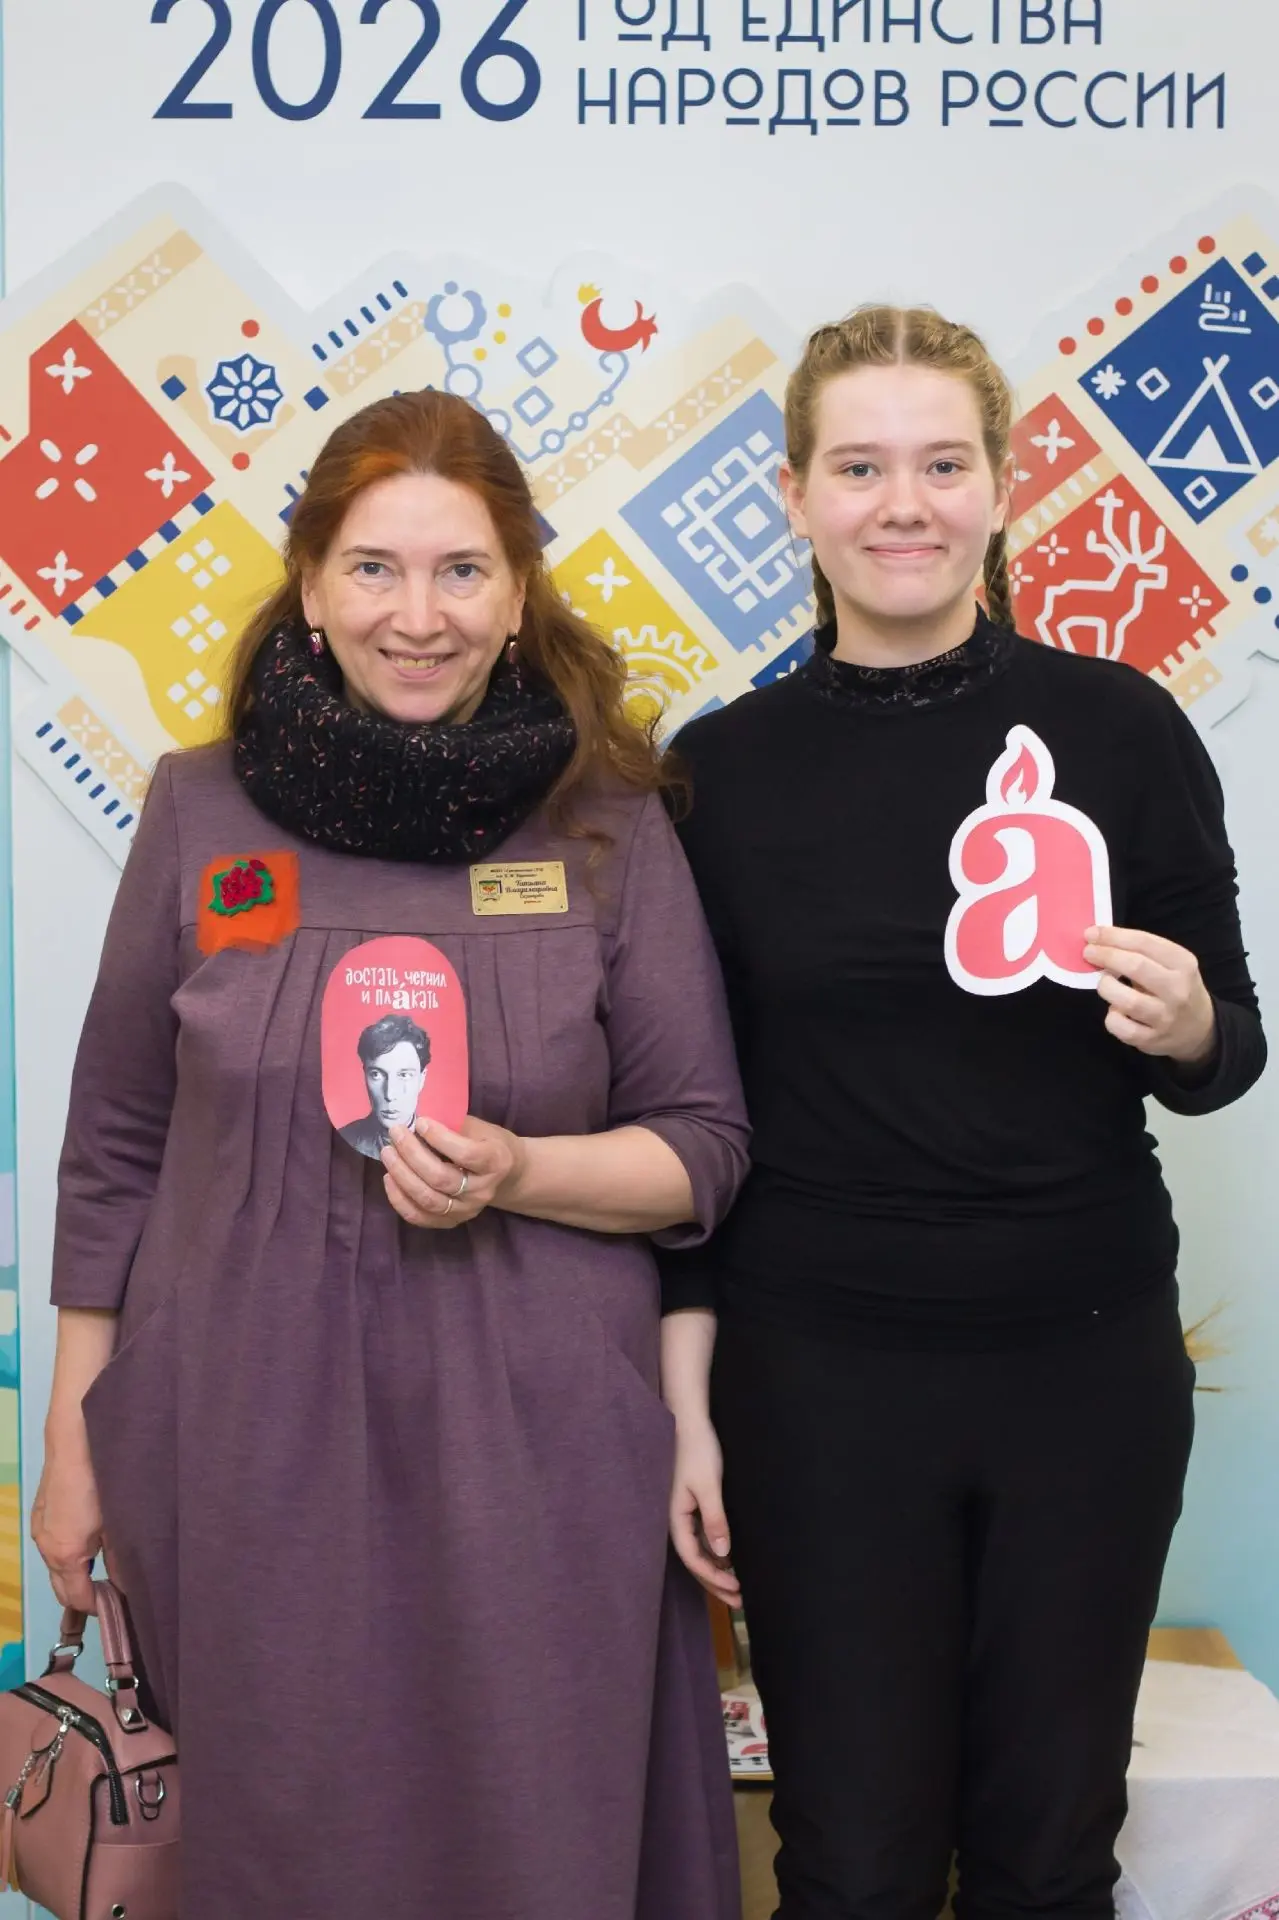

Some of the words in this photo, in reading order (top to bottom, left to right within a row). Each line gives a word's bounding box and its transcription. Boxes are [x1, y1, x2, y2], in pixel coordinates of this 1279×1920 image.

[151, 0, 541, 122] 2026
[578, 67, 910, 136] НАРОДОВ
[941, 70, 1225, 130] РОССИИ
